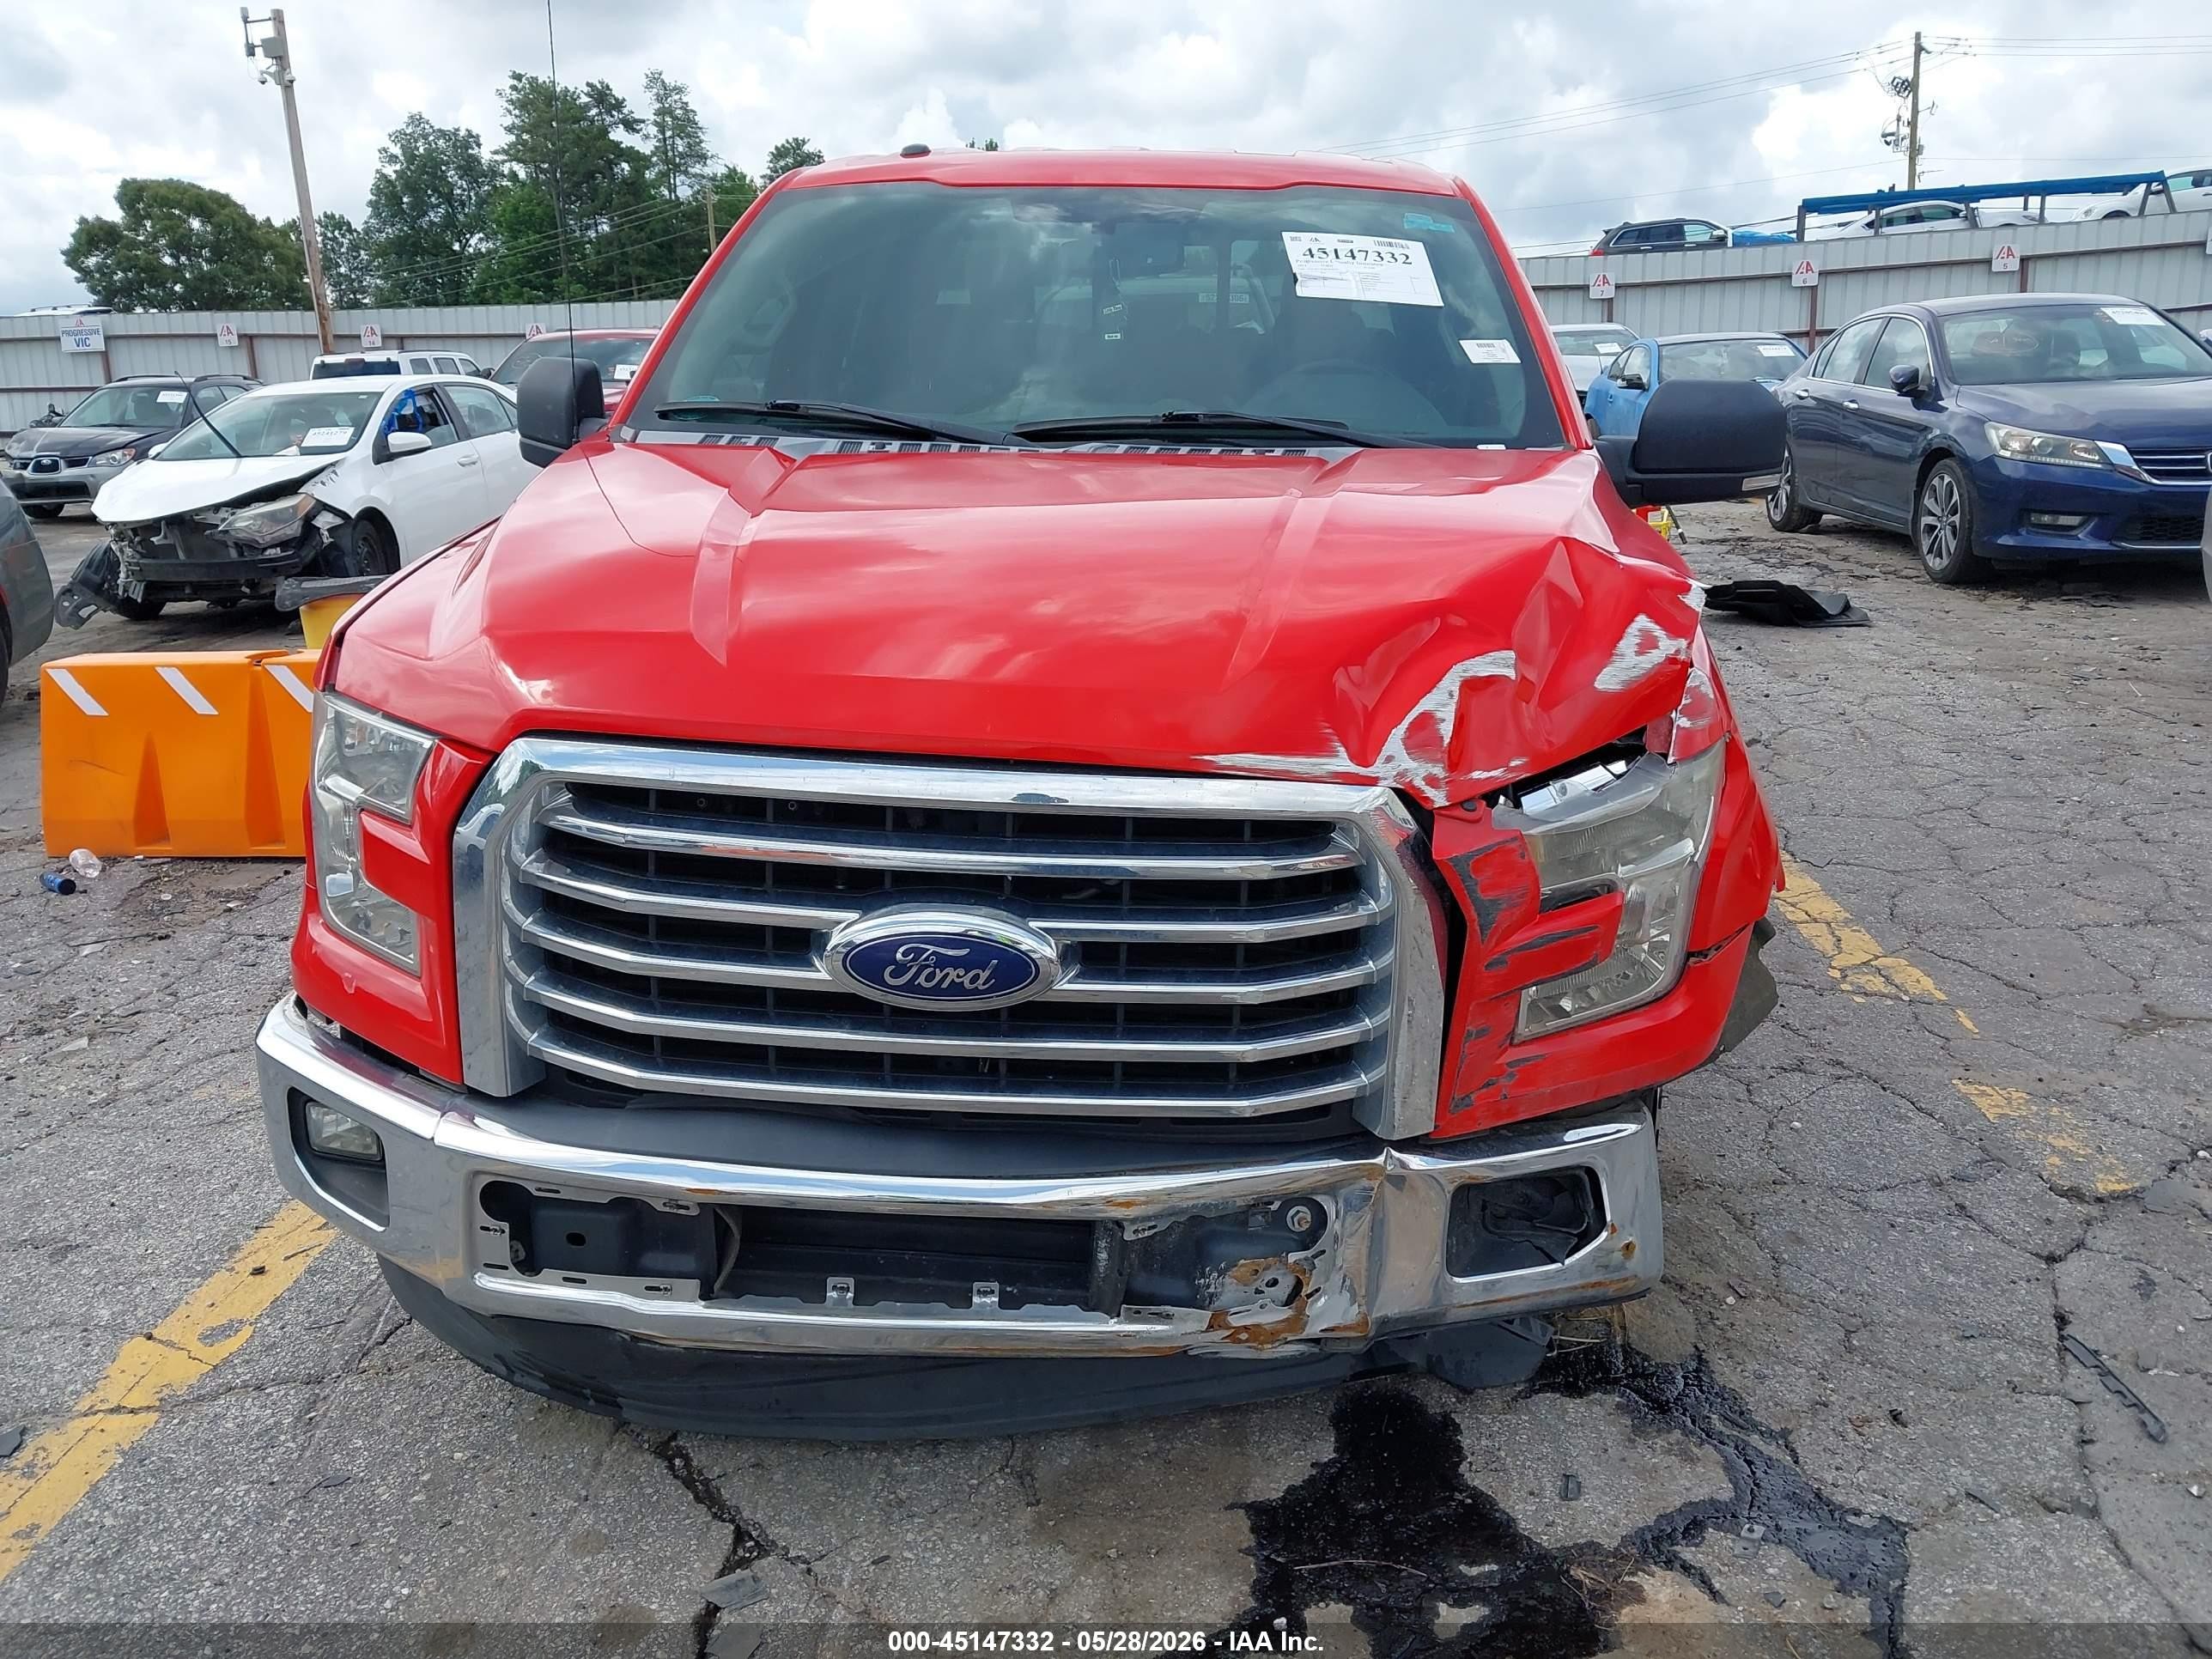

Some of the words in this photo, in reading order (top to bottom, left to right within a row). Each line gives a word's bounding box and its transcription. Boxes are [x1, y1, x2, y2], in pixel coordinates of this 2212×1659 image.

[1302, 247, 1413, 264] 45147332
[61, 328, 101, 337] PROGRESSIVE
[74, 337, 91, 348] VIC
[884, 943, 999, 990] Ford
